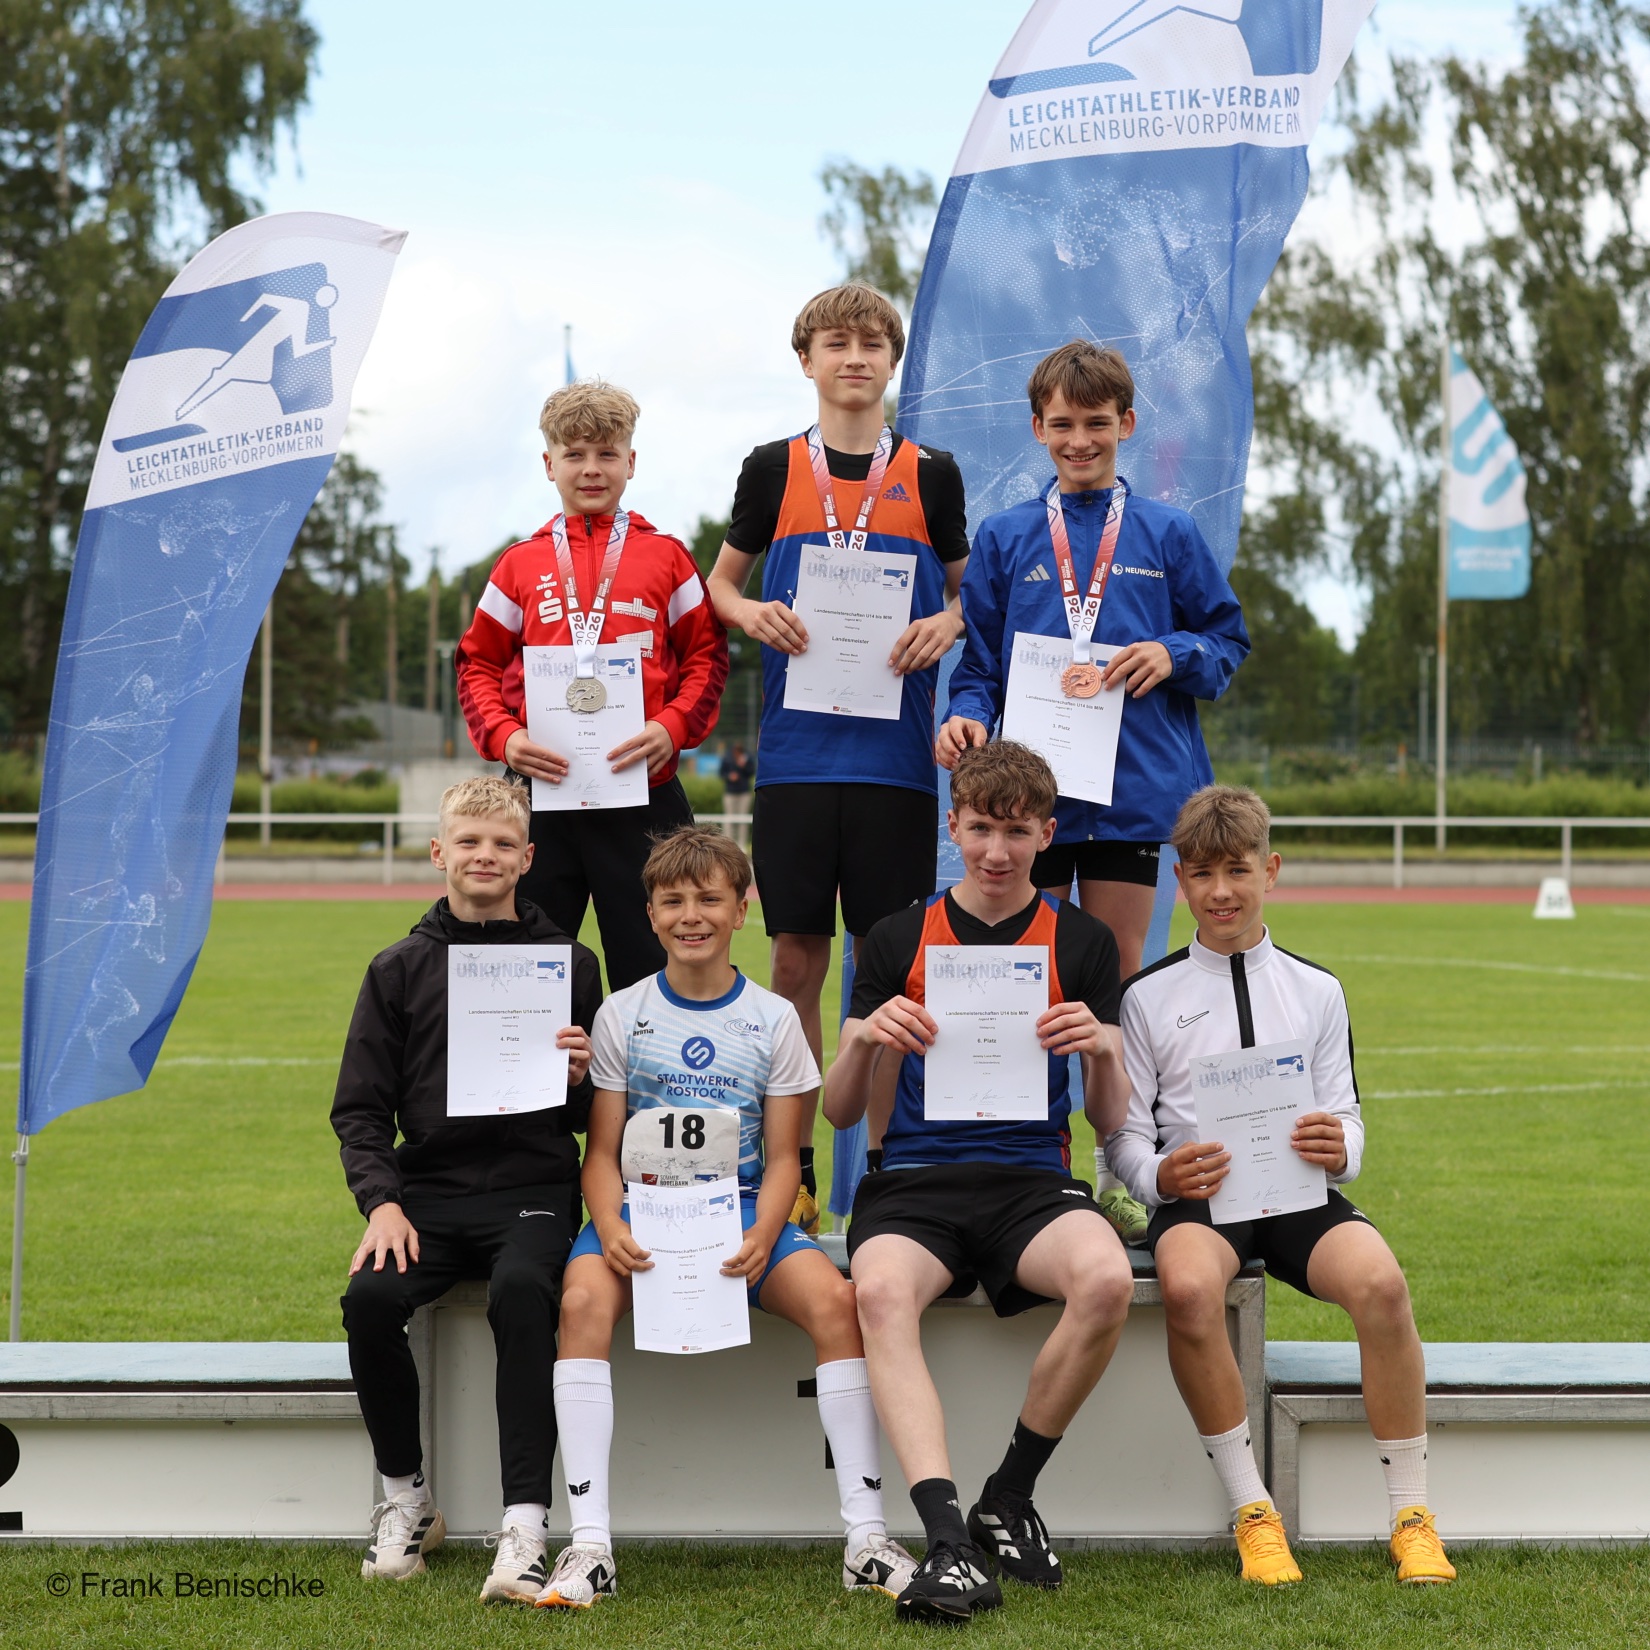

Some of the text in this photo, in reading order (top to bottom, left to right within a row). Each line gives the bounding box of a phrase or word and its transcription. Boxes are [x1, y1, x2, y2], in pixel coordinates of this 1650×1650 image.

[1008, 85, 1300, 127] LEICHTATHLETIK-VERBAND
[1009, 111, 1301, 152] MECKLENBURG-VORPOMMERN
[127, 417, 324, 473] LEICHTATHLETIK-VERBAND
[129, 434, 324, 490] MECKLENBURG-VORPOMMERN
[882, 493, 911, 503] adidas
[806, 561, 882, 581] URKUNDE
[1125, 566, 1164, 579] NEUWOGES
[536, 581, 558, 591] erima
[1081, 600, 1098, 632] 2026
[585, 615, 602, 646] 2026
[456, 962, 535, 978] URKUNDE
[933, 963, 1012, 979] URKUNDE
[632, 1027, 654, 1037] erima
[657, 1073, 739, 1088] STADTWERKE
[1199, 1062, 1275, 1088] URKUNDE
[666, 1086, 726, 1099] ROSTOCK
[658, 1112, 706, 1150] 18
[635, 1200, 709, 1219] URKUNDE
